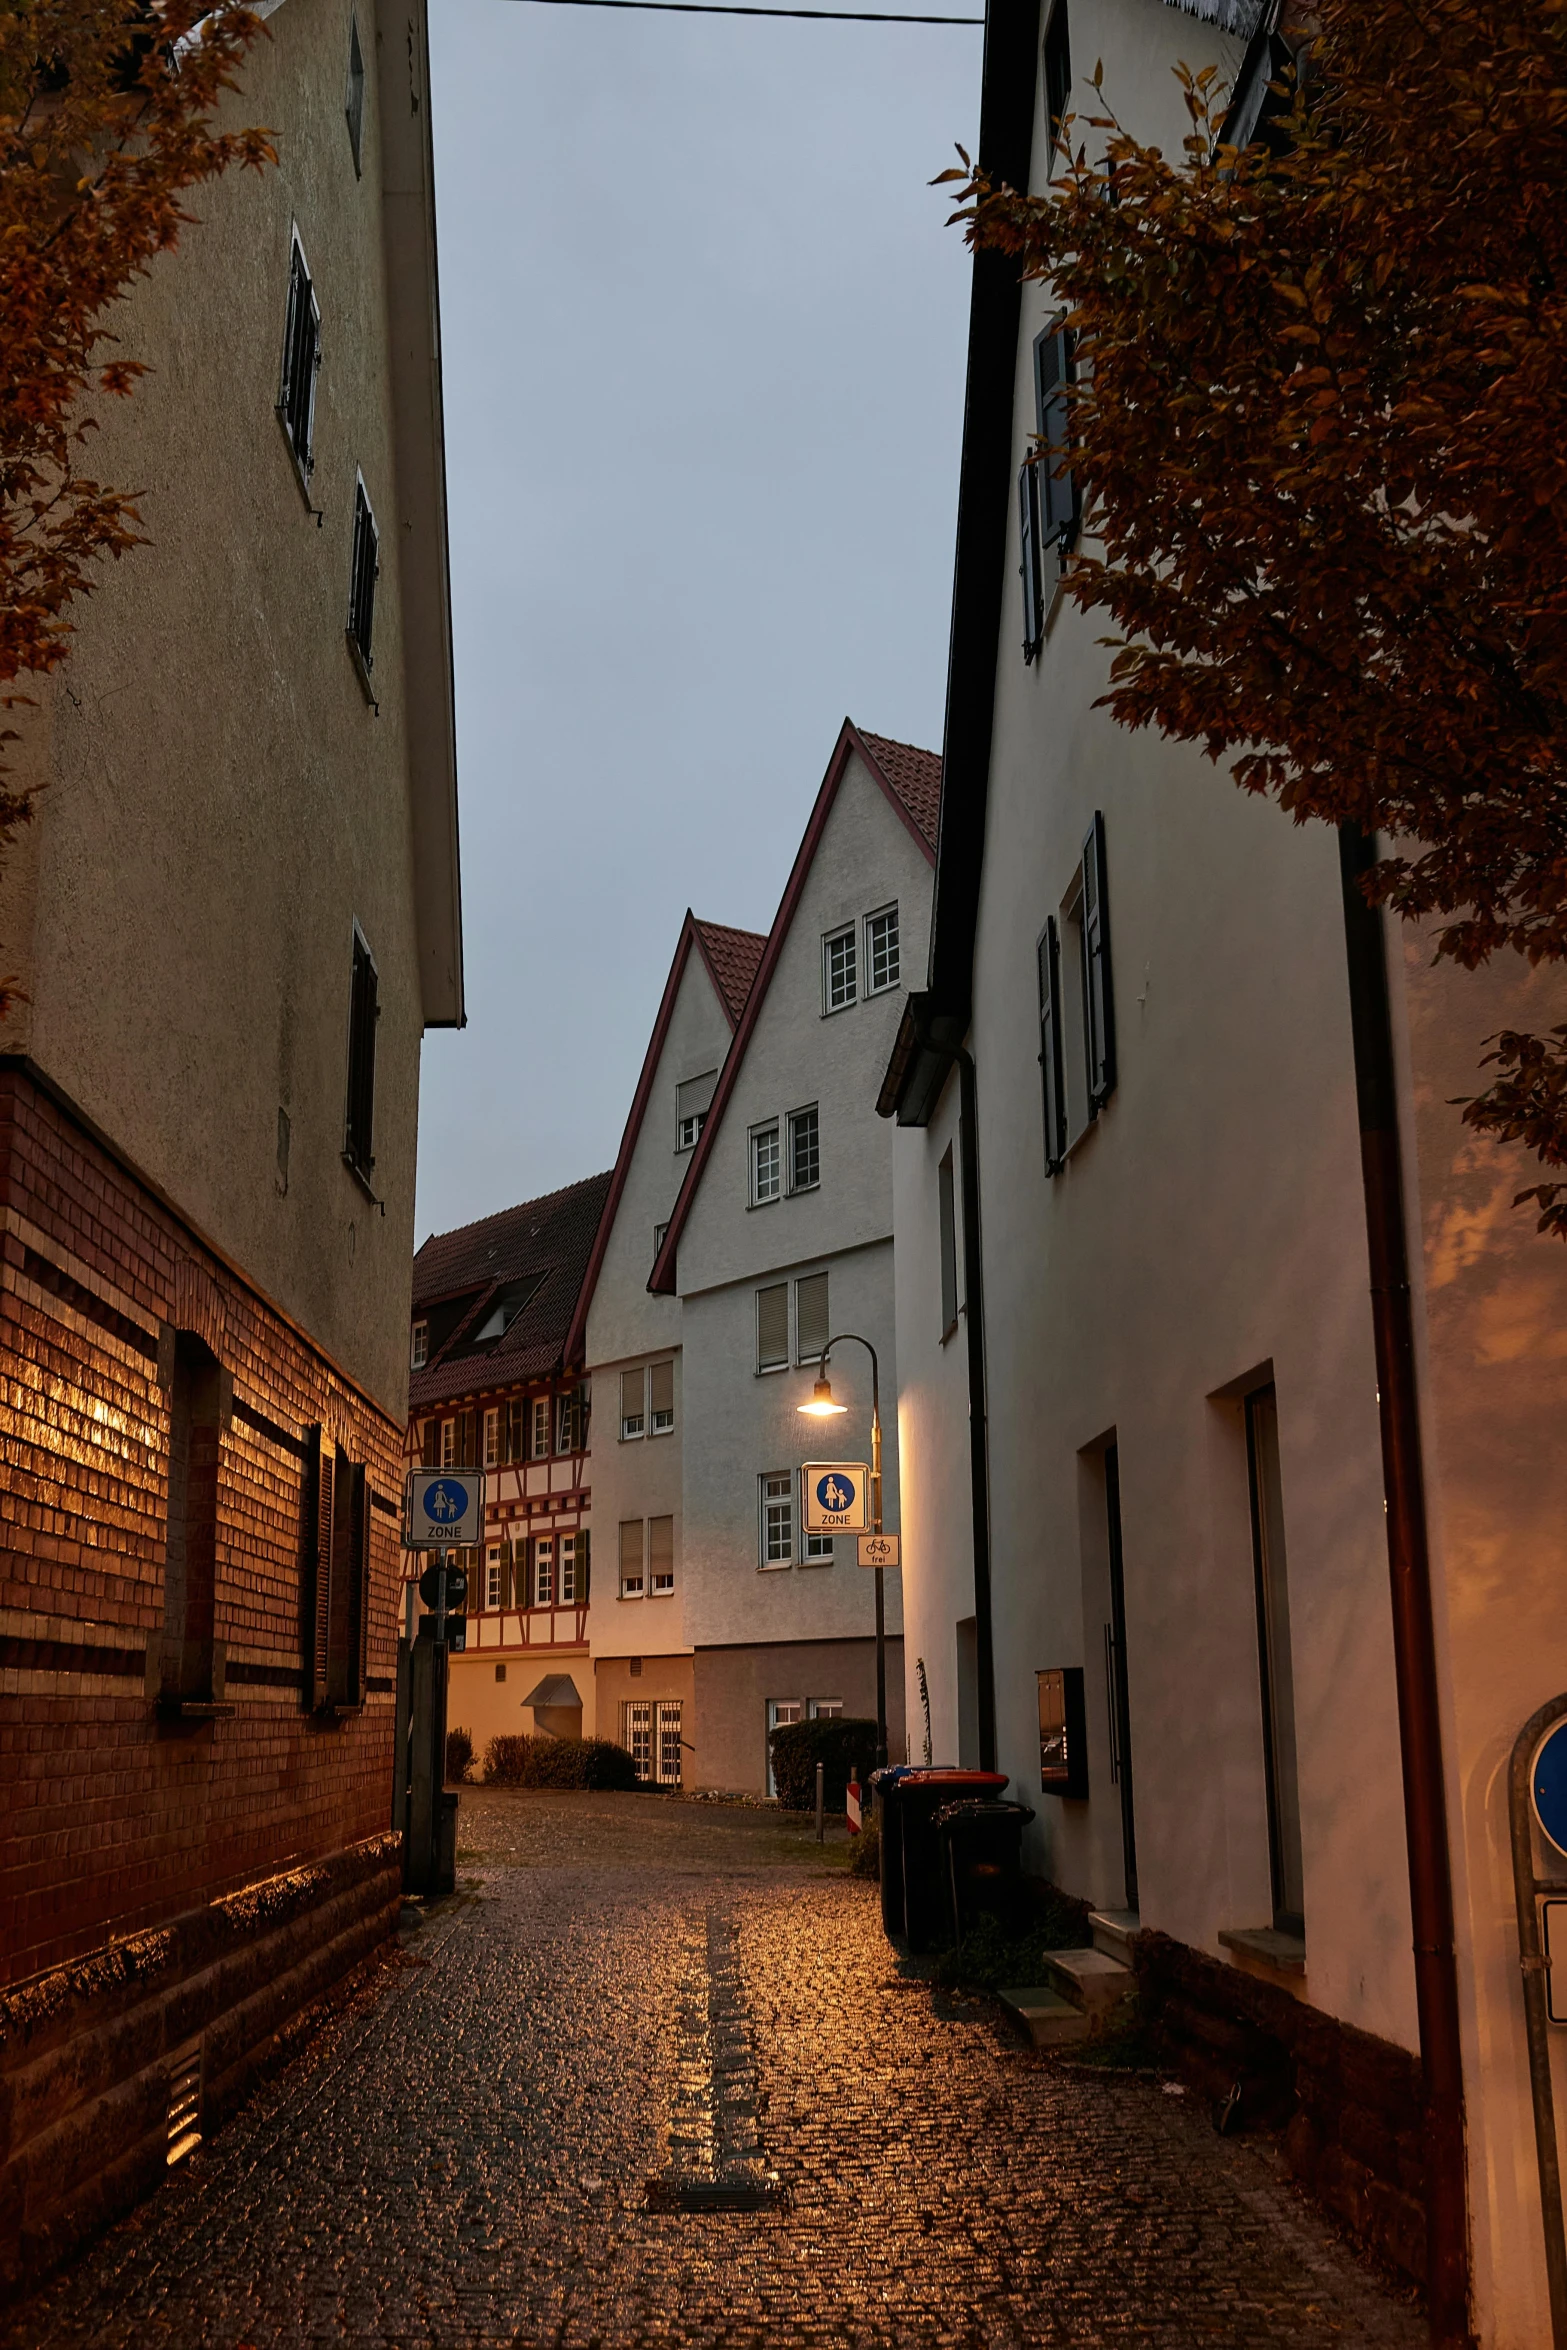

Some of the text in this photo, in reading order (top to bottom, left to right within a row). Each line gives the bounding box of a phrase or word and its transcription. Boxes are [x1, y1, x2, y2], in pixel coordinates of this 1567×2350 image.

[821, 1515, 851, 1525] ZONE
[428, 1526, 462, 1538] ZONE
[871, 1555, 886, 1563] frei
